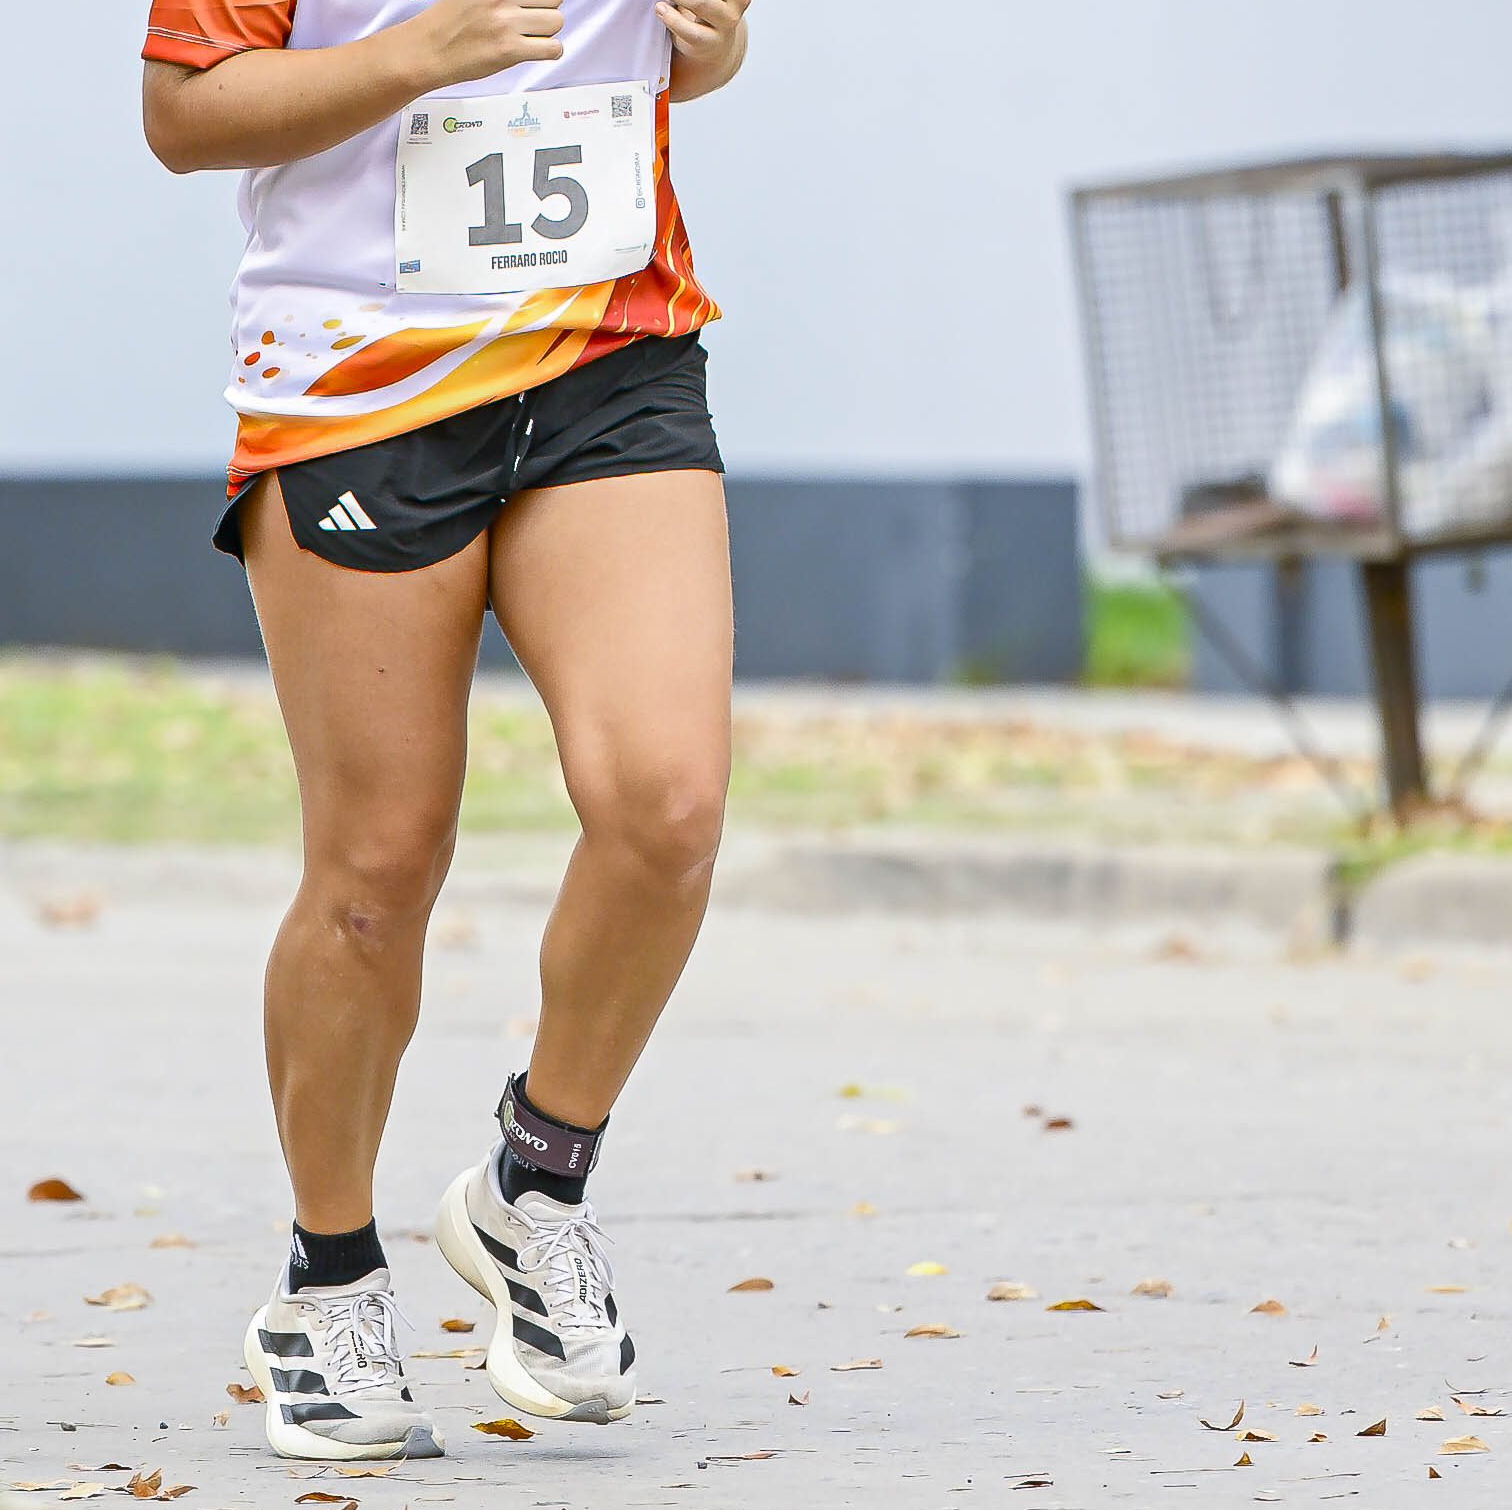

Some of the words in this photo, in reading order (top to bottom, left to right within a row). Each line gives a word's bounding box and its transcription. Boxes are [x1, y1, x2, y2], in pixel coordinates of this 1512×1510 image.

[465, 145, 588, 246] 15
[491, 253, 536, 269] FERRARO
[540, 250, 567, 265] ROCIO
[574, 1257, 588, 1304] ADIZERO
